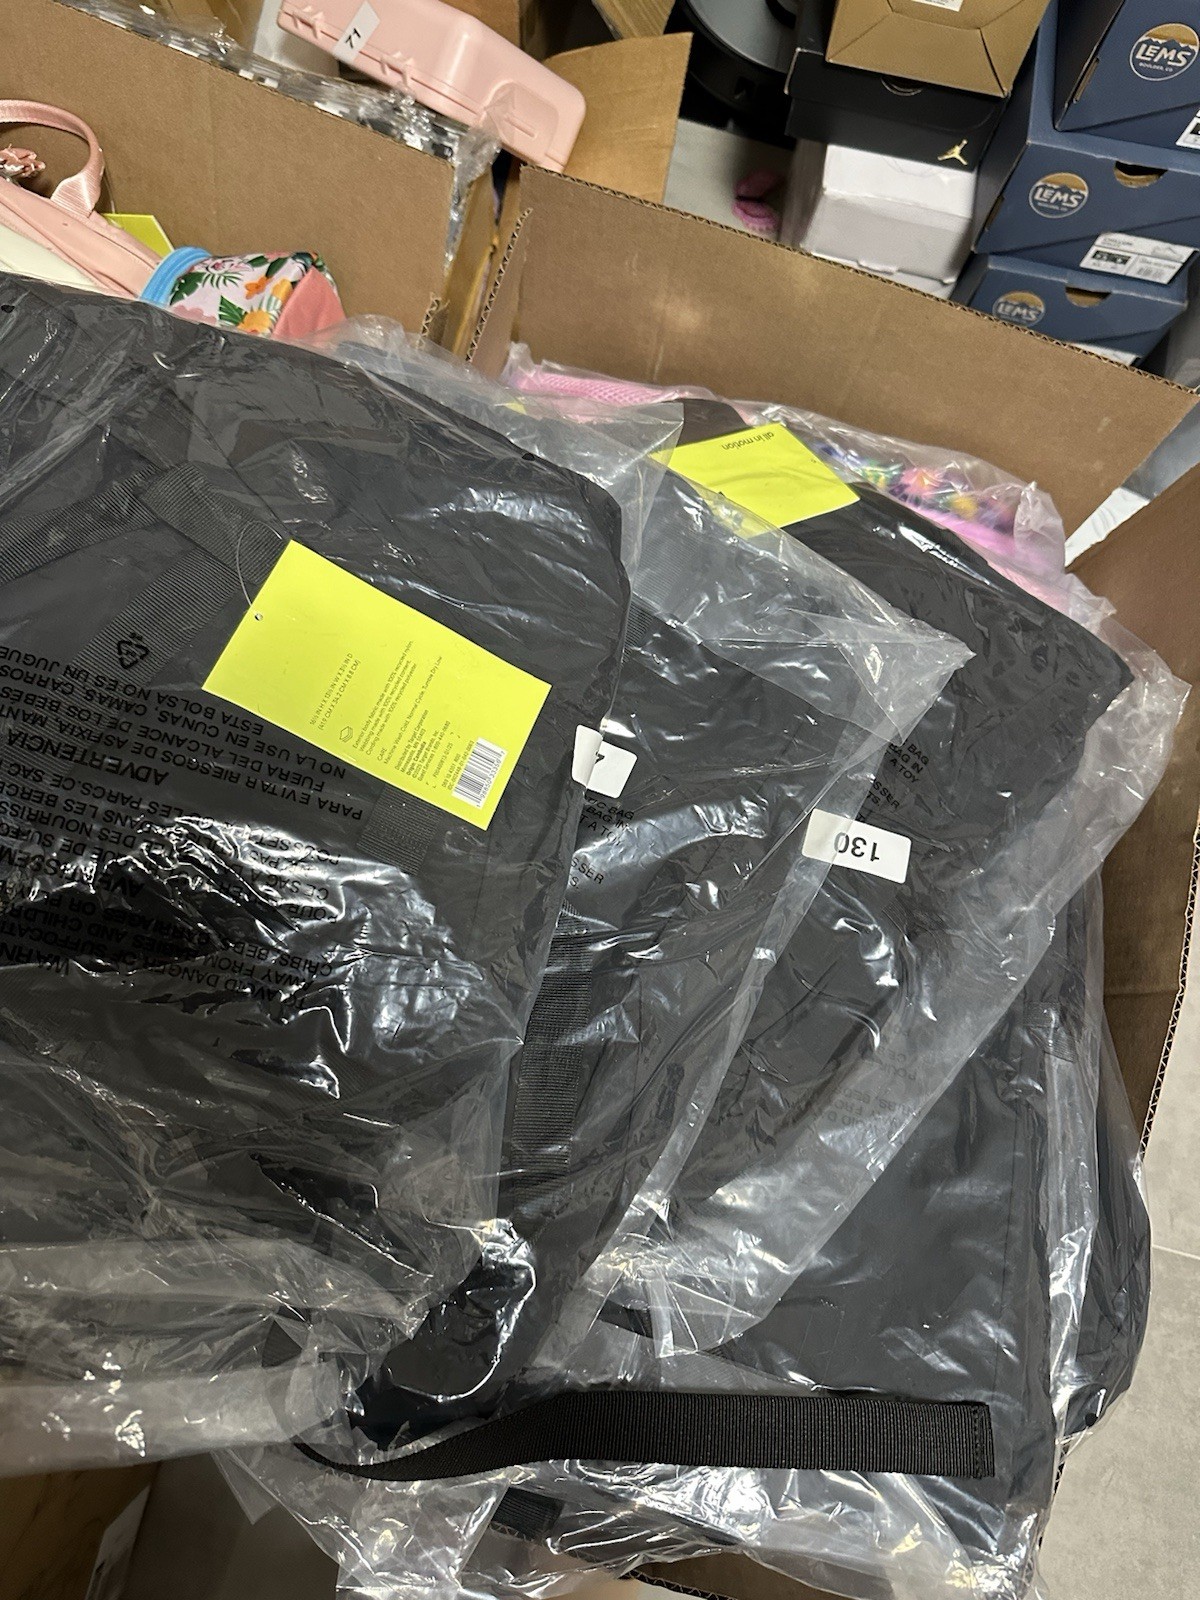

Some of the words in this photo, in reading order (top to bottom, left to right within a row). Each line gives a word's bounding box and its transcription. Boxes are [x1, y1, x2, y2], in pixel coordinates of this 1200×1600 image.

[344, 28, 361, 48] 71
[1136, 43, 1191, 67] LEMS
[1034, 187, 1083, 208] LEMS
[998, 302, 1040, 322] LEMS
[721, 436, 754, 450] motion
[752, 434, 763, 444] in
[763, 432, 774, 442] all
[430, 665, 439, 675] Dry
[434, 655, 443, 666] Low
[0, 662, 75, 698] CARROS
[61, 664, 89, 683] UN
[93, 674, 118, 691] ES
[421, 673, 434, 690] Tumble
[121, 681, 151, 700] NO
[324, 707, 333, 718] CM
[338, 681, 348, 693] CM
[352, 730, 365, 749] Exterior
[361, 718, 373, 732] body
[368, 704, 379, 719] fabric
[375, 692, 386, 706] made
[382, 682, 391, 693] with
[387, 670, 397, 683] 100%
[393, 652, 407, 672] recycled
[65, 703, 102, 726] LOS
[153, 690, 216, 720] BOLSA
[358, 730, 375, 752] Webbing
[370, 716, 381, 731] made
[377, 706, 386, 718] with
[382, 694, 392, 708] 100%
[388, 676, 403, 696] recycled
[406, 703, 418, 720] Normal
[105, 715, 133, 734] DE
[151, 705, 221, 738] CUNAS,
[218, 710, 265, 736] ESTA
[365, 735, 380, 756] Cording
[375, 722, 386, 737] made
[382, 712, 392, 723] with
[387, 700, 398, 714] 100%
[393, 682, 408, 702] recycled
[51, 716, 128, 752] ASFIXIA,
[135, 723, 224, 761] ALCANCE
[224, 730, 250, 748] EN
[393, 730, 404, 745] Wash
[394, 746, 410, 770] Distributed
[407, 730, 418, 744] Target
[414, 708, 430, 732] Corporation
[412, 740, 419, 749] MN
[4, 723, 169, 791] ADVERTENCIA
[130, 740, 158, 759] DE
[252, 739, 291, 762] USE
[293, 752, 316, 769] LA
[376, 747, 387, 761] CARE
[383, 744, 397, 764] Machine
[405, 761, 416, 776] Origin:
[412, 740, 427, 762] Cambodia
[418, 750, 429, 764] Target
[886, 742, 911, 763] BAG
[910, 761, 923, 773] IN
[906, 742, 931, 765] BAG
[5, 761, 46, 784] SAC
[159, 748, 241, 784] RIESGOS
[225, 751, 263, 773] DEL
[318, 760, 346, 779] NO
[416, 768, 427, 781] Guest
[422, 752, 435, 769] Services
[888, 756, 898, 767] A
[896, 764, 919, 784] TOY
[264, 763, 325, 792] FUERA
[244, 774, 311, 805] EVITAR
[61, 797, 99, 819] LES
[146, 800, 184, 821] LES
[314, 796, 363, 821] PARA
[585, 802, 612, 825] BAG
[607, 800, 635, 825] BAG
[587, 819, 599, 831] A
[60, 837, 87, 856] DE
[96, 826, 136, 849] DES
[834, 832, 880, 862] 130
[85, 921, 128, 945] AND
[201, 952, 255, 976] FROM
